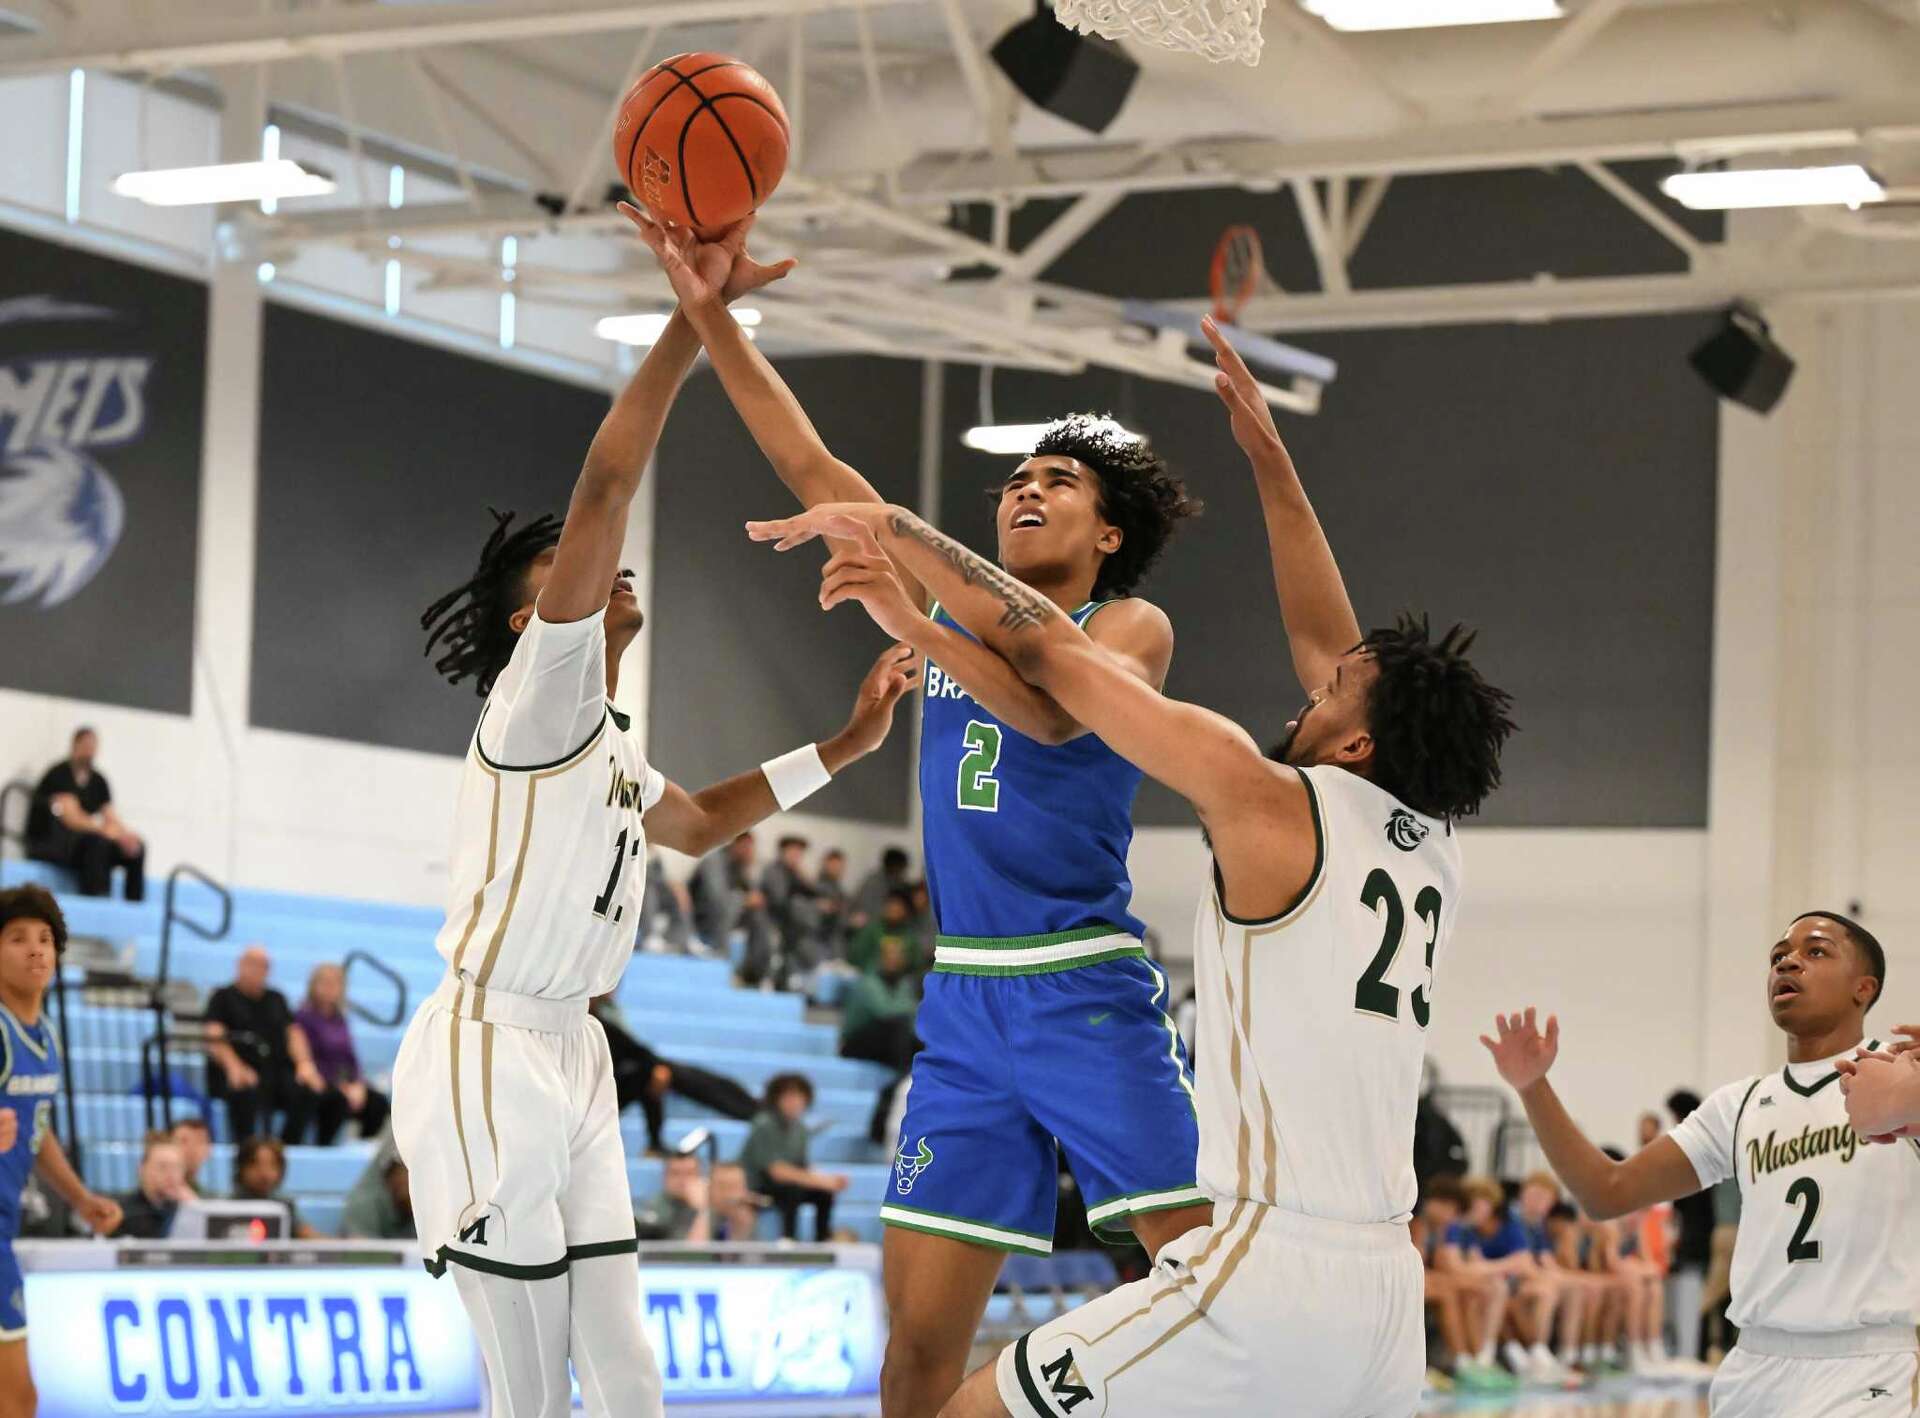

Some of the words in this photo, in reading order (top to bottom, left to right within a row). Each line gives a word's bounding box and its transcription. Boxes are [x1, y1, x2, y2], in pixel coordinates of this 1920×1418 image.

[0, 358, 150, 452] METS
[957, 719, 1002, 812] 2
[1355, 868, 1443, 1030] 23
[1785, 1176, 1823, 1263] 2
[104, 1297, 421, 1402] CONTRA
